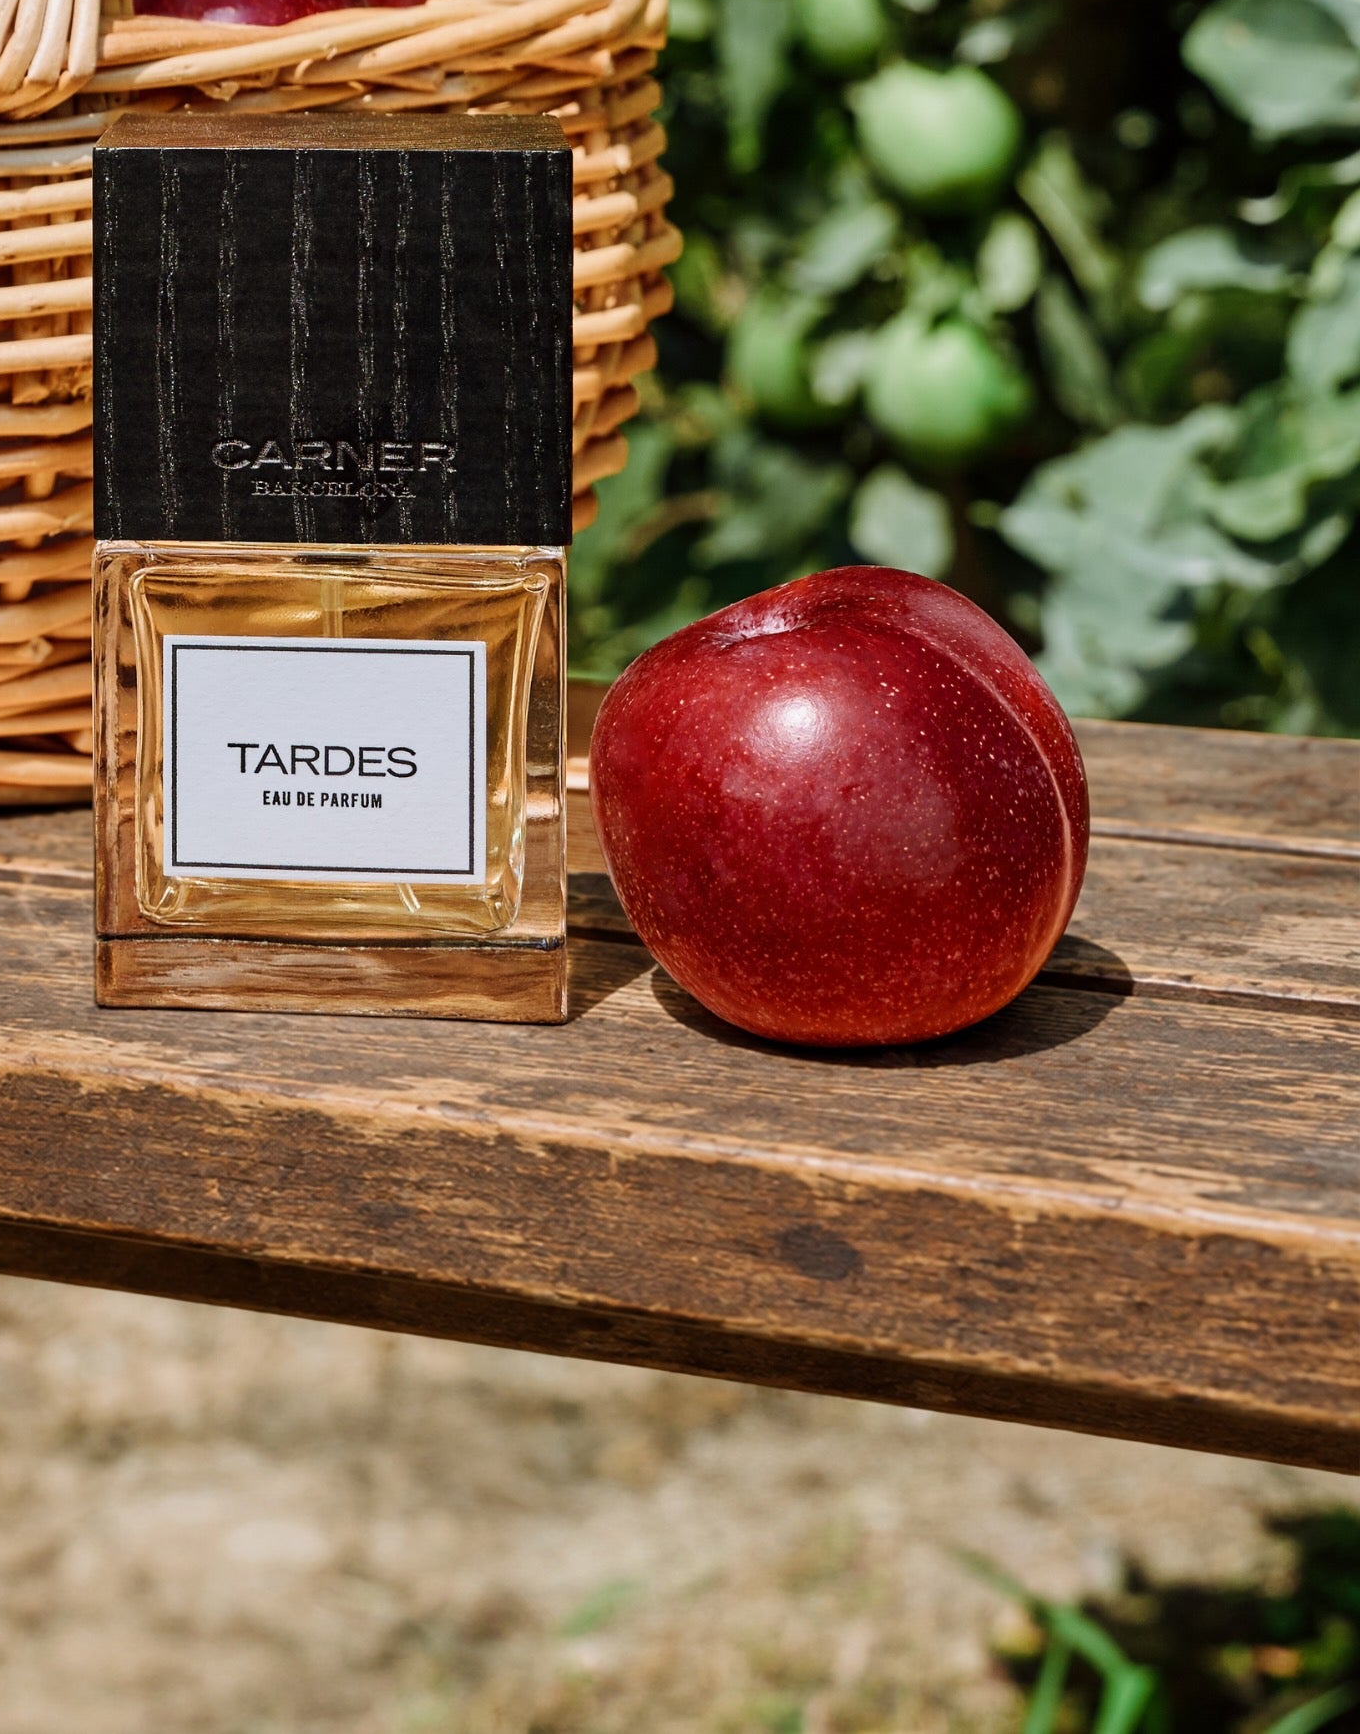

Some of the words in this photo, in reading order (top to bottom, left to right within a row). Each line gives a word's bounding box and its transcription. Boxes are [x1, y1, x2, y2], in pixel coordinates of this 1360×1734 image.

[211, 439, 458, 473] CARNER
[227, 742, 418, 778] TARDES
[262, 790, 291, 806] EAU
[296, 791, 315, 807] DE
[320, 792, 382, 809] PARFUM
